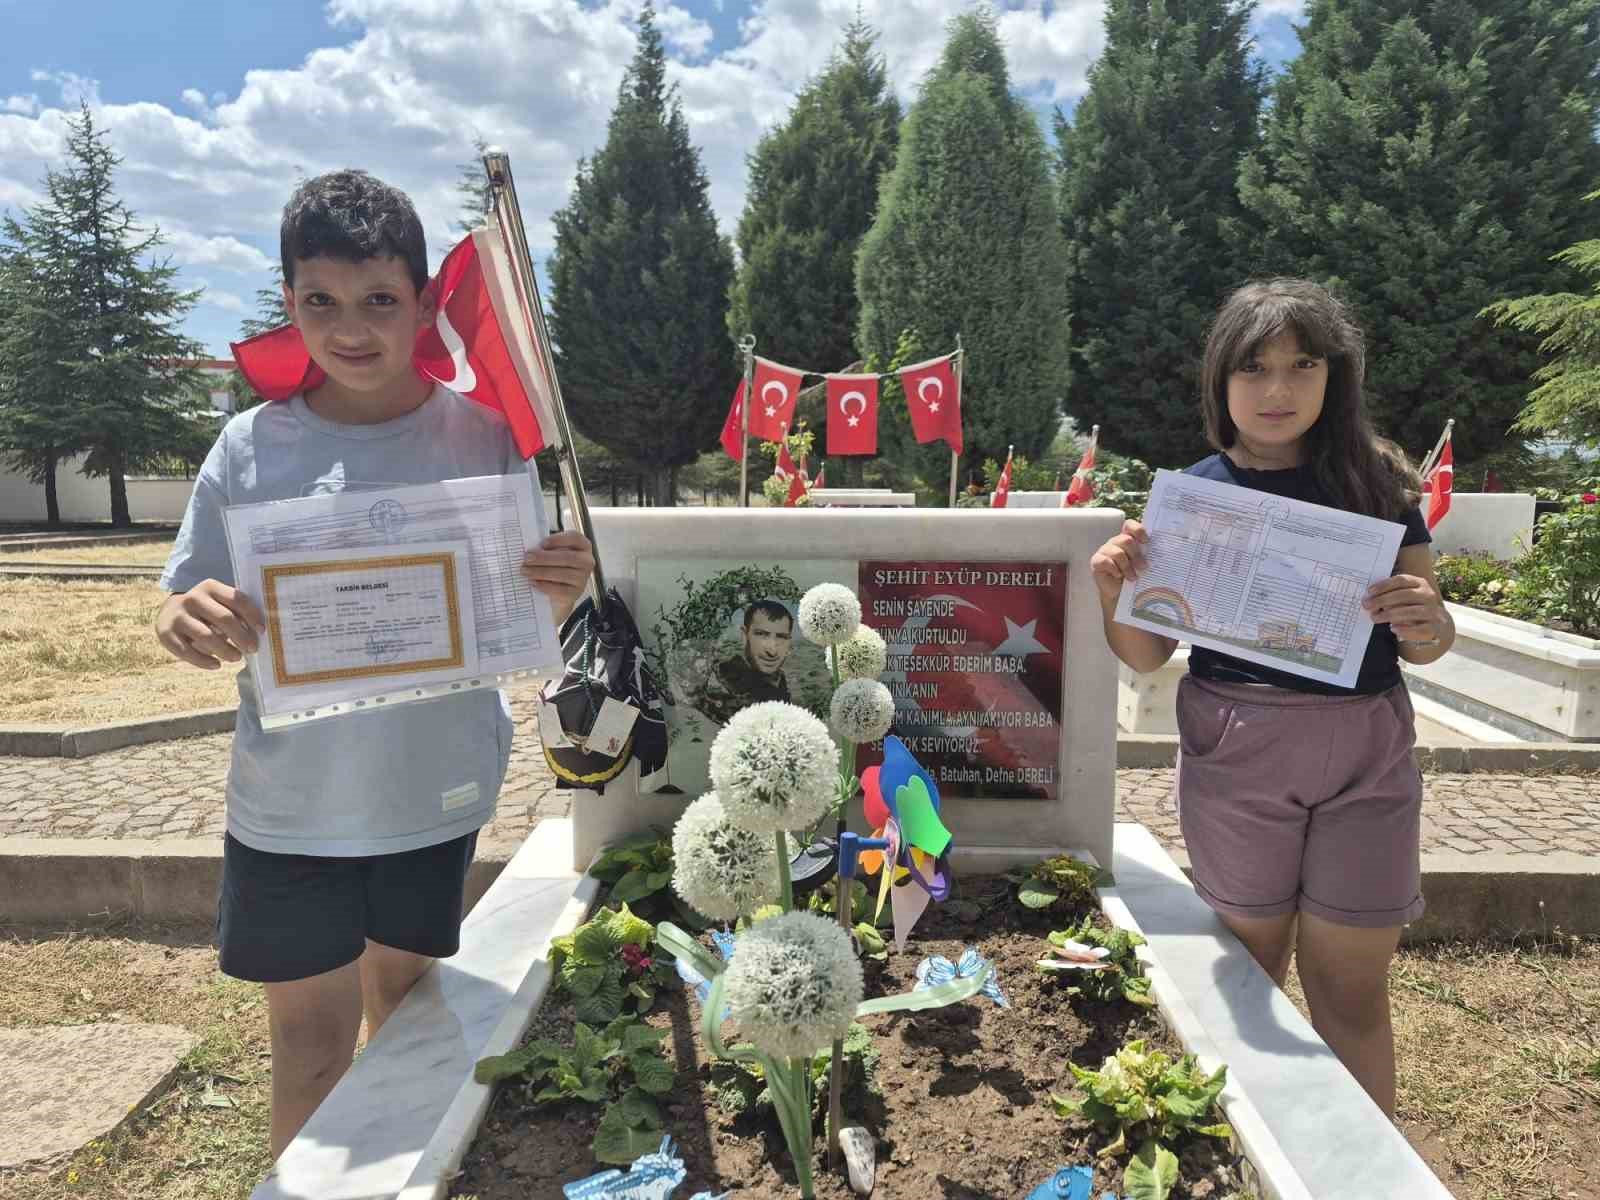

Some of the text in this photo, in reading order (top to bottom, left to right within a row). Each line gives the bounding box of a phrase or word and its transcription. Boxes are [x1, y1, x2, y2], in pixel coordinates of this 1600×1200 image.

[874, 567, 1053, 587] ŞEHİT EYÜP DERELİ
[873, 597, 955, 617] SENİN SAYENDE
[911, 628, 968, 645] KURTULDU
[953, 652, 992, 673] EDERİM
[1025, 711, 1053, 729] BABA
[986, 767, 1015, 784] Defne
[1017, 764, 1054, 784] DERELİ
